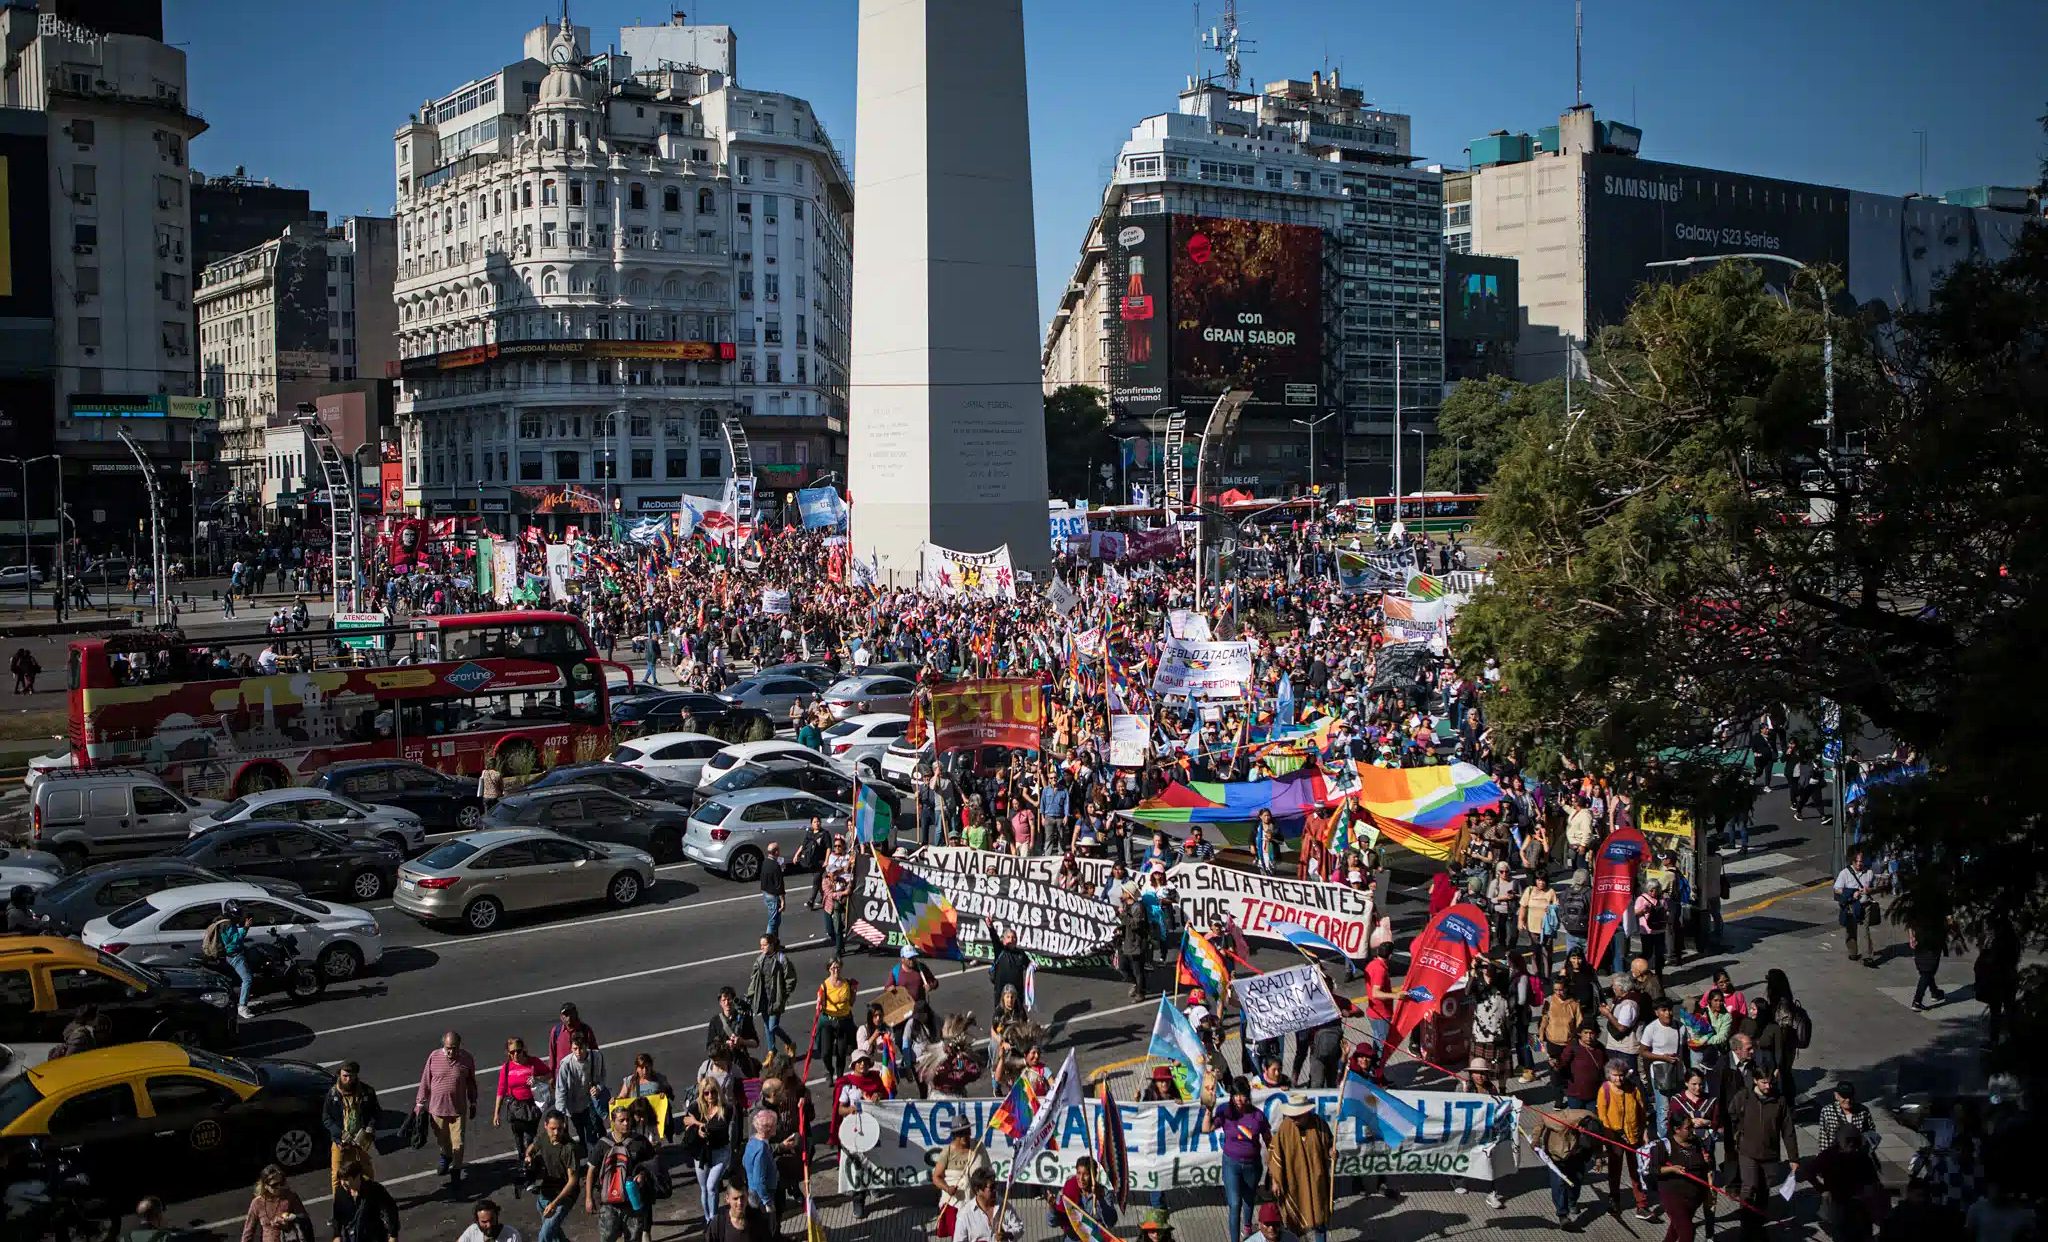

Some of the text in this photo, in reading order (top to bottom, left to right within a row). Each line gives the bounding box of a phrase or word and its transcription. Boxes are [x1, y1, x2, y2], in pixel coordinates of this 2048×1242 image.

[1604, 175, 1679, 202] SAMSUNG
[1675, 223, 1780, 249] Galaxy S23 Series
[1237, 311, 1263, 324] con
[1203, 328, 1297, 346] GRAN SABOR
[1130, 393, 1161, 402] mismo!
[942, 549, 997, 565] FRENTE
[1201, 648, 1248, 661] ATACAMA
[1201, 680, 1242, 689] REFORMA
[932, 684, 1040, 730] PSTU
[544, 736, 569, 747] 4078
[405, 750, 425, 759] CITY
[953, 851, 1055, 885] NACIONES
[973, 870, 1001, 896] ES
[1008, 877, 1049, 906] PARA
[1195, 865, 1255, 896] SALTA
[1258, 878, 1367, 915] PRESENTES
[1597, 883, 1632, 892] CITY BUS
[942, 888, 1043, 926] VERDURAS
[1045, 908, 1057, 930] Y
[1058, 912, 1097, 941] CRIA
[1445, 920, 1474, 942] TICKETS
[1419, 956, 1458, 976] CITY BUS
[1247, 969, 1296, 997] ABAJO
[1244, 981, 1325, 1015] REFORMA
[1156, 1105, 1225, 1155] MA
[846, 1152, 919, 1188] Cuenca
[1144, 1170, 1159, 1189] y
